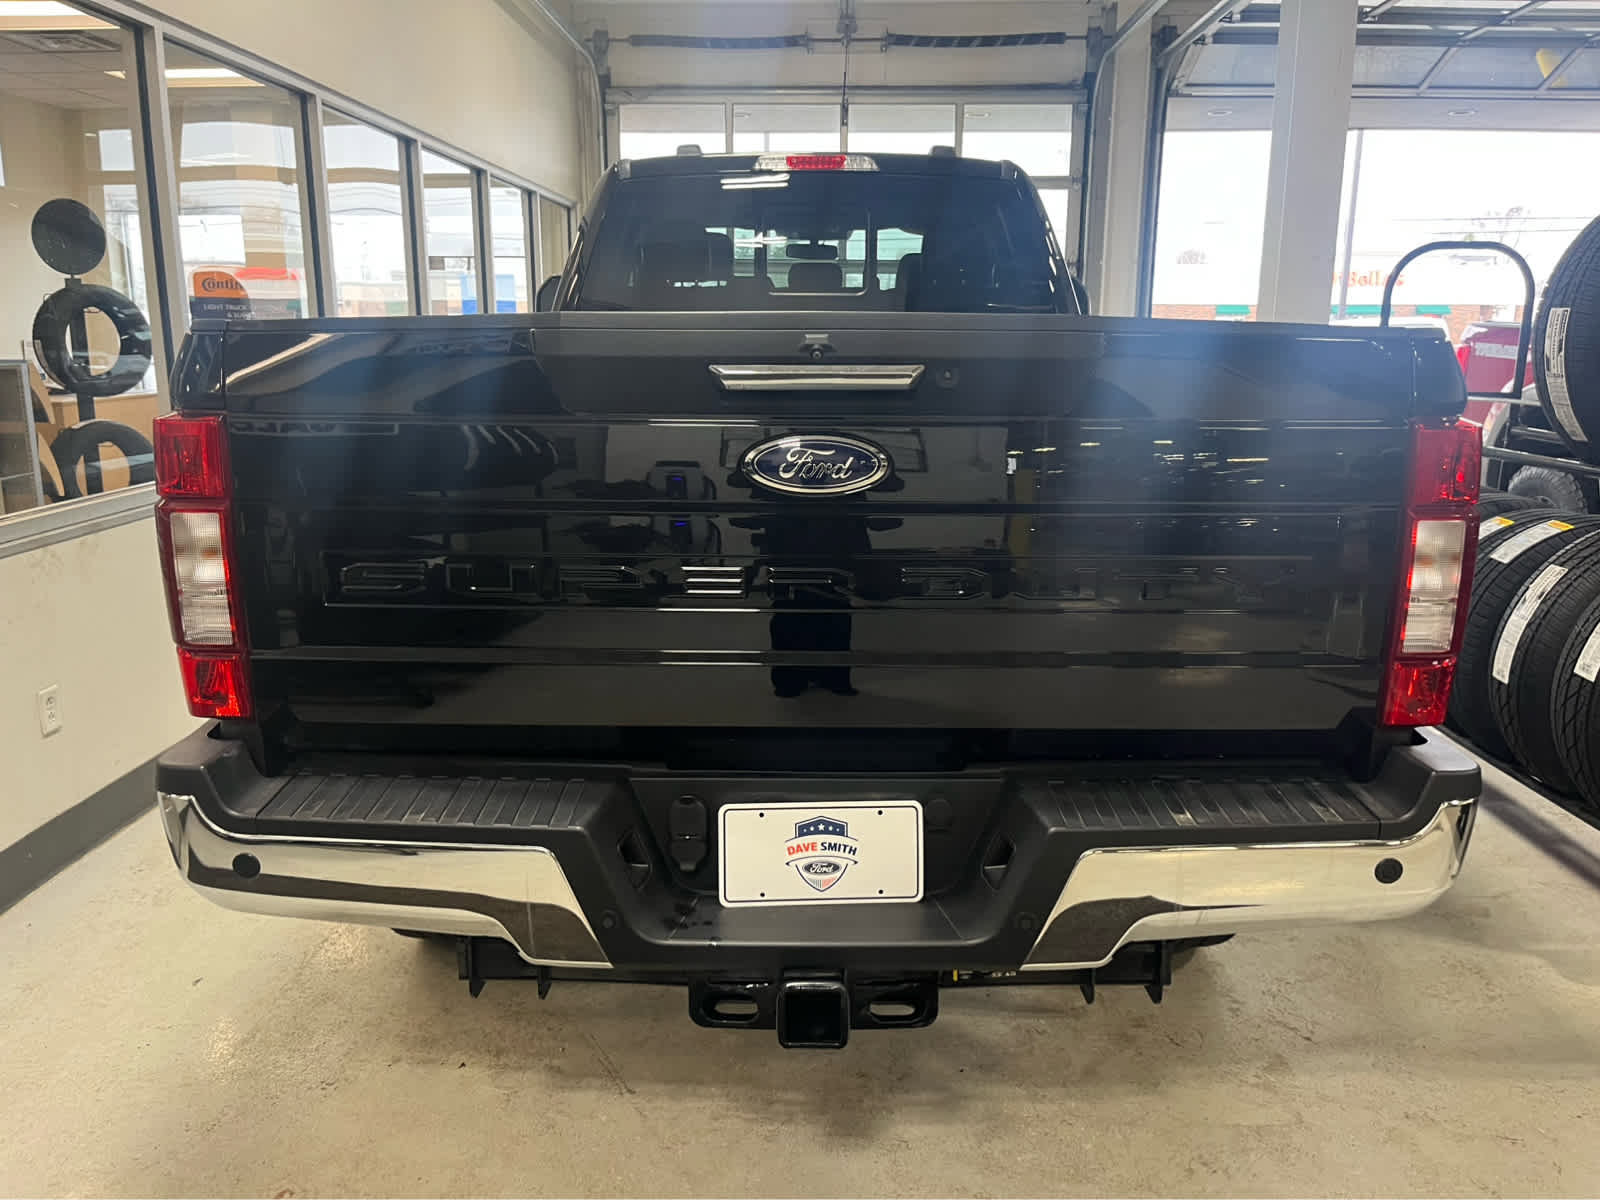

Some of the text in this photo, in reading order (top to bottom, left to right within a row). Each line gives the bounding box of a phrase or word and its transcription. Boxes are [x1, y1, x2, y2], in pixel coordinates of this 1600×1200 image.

[779, 447, 854, 479] Ford
[339, 560, 858, 600] SUPER
[787, 842, 857, 855] DAVE SMITH
[810, 863, 834, 873] Ford
